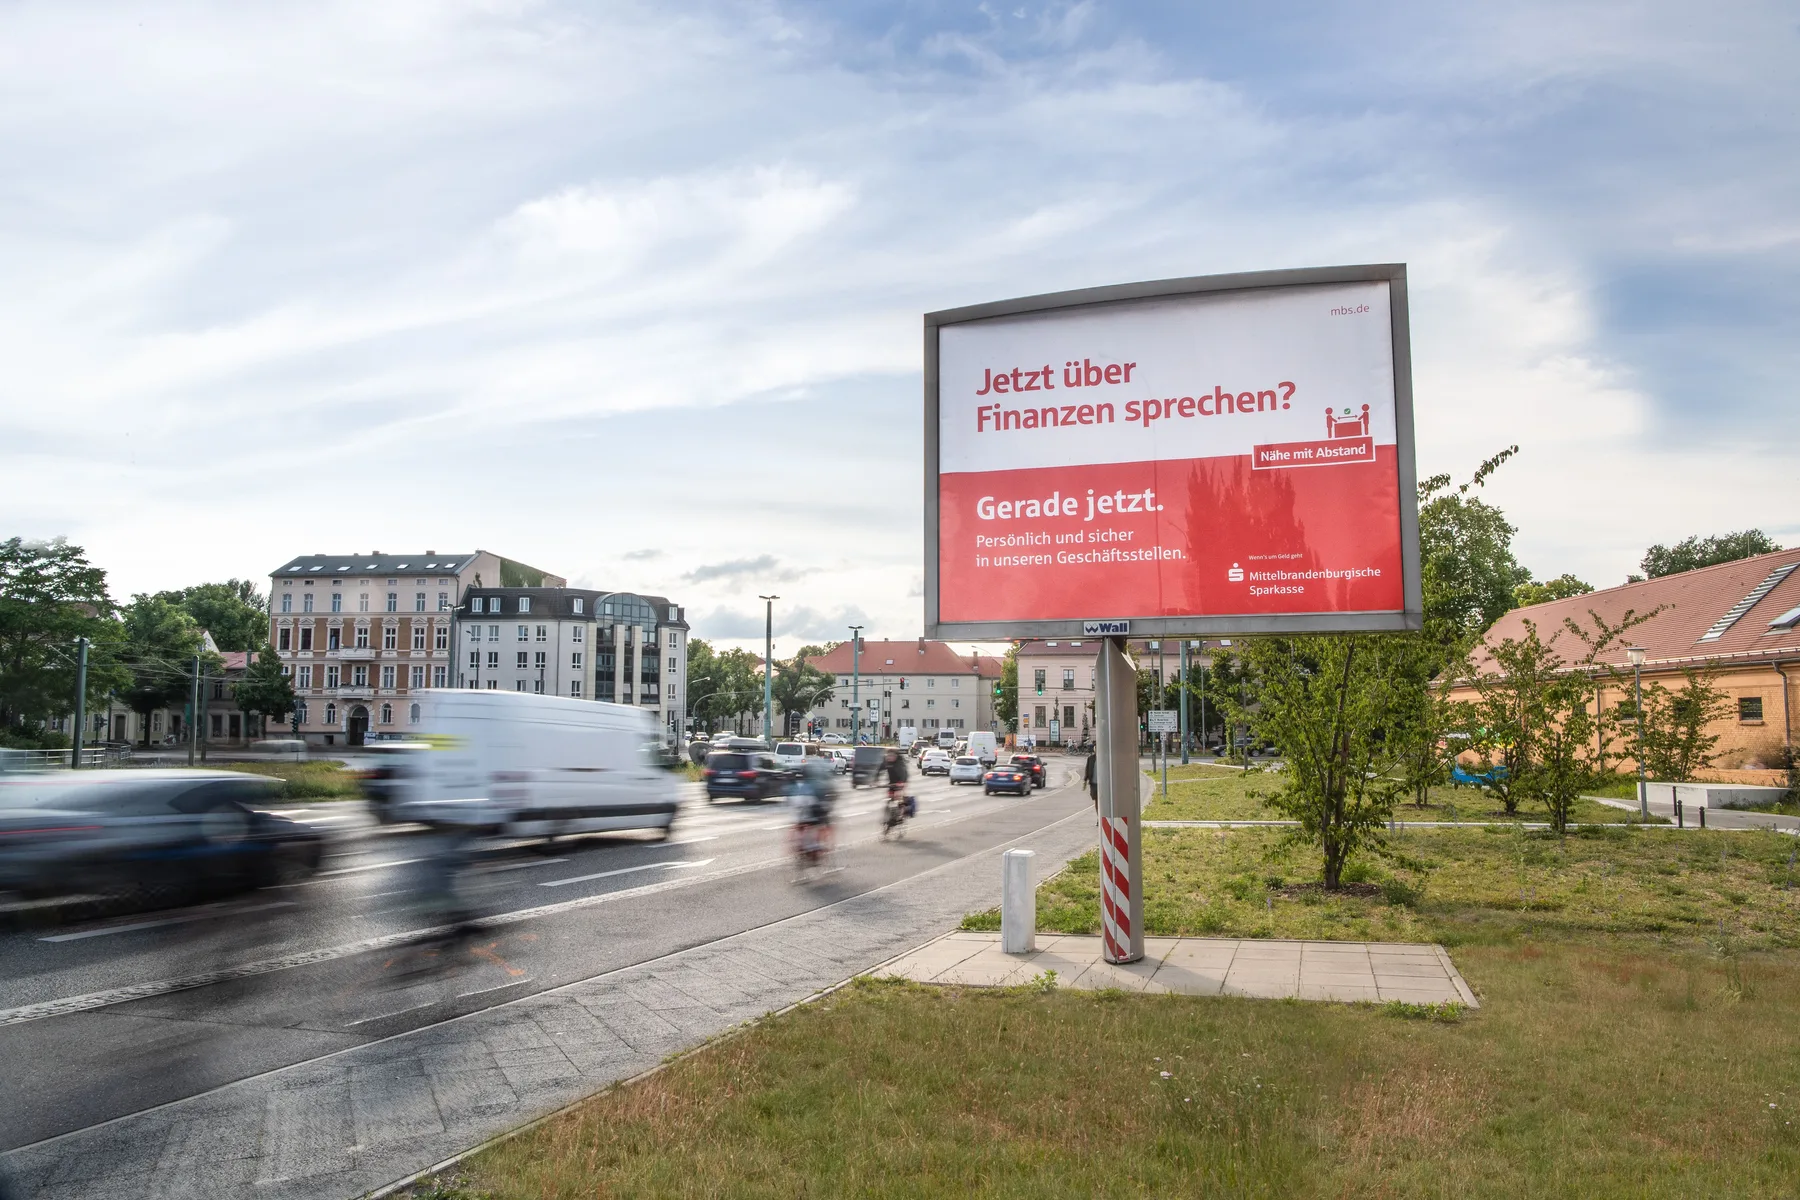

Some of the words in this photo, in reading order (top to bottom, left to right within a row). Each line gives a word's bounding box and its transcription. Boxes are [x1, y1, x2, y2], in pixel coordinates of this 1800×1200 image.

[1330, 304, 1370, 316] mbs.de
[975, 364, 1055, 396] Jetzt
[1063, 358, 1136, 388] über
[977, 402, 1115, 432] Finanzen
[1124, 381, 1297, 428] sprechen?
[1261, 450, 1291, 462] Nähe
[1293, 447, 1313, 459] mit
[1316, 444, 1366, 458] Abstand
[976, 491, 1078, 520] Gerade
[1083, 487, 1164, 521] jetzt.
[976, 531, 1051, 548] Persönlich
[1055, 529, 1084, 544] und
[1088, 528, 1134, 543] sicher
[976, 554, 989, 567] in
[993, 553, 1052, 566] unseren
[1056, 546, 1187, 564] Geschäftsstellen.
[1249, 567, 1381, 581] Mittelbrandenburgische
[1249, 584, 1305, 597] Sparkasse
[1098, 622, 1128, 633] Wall
